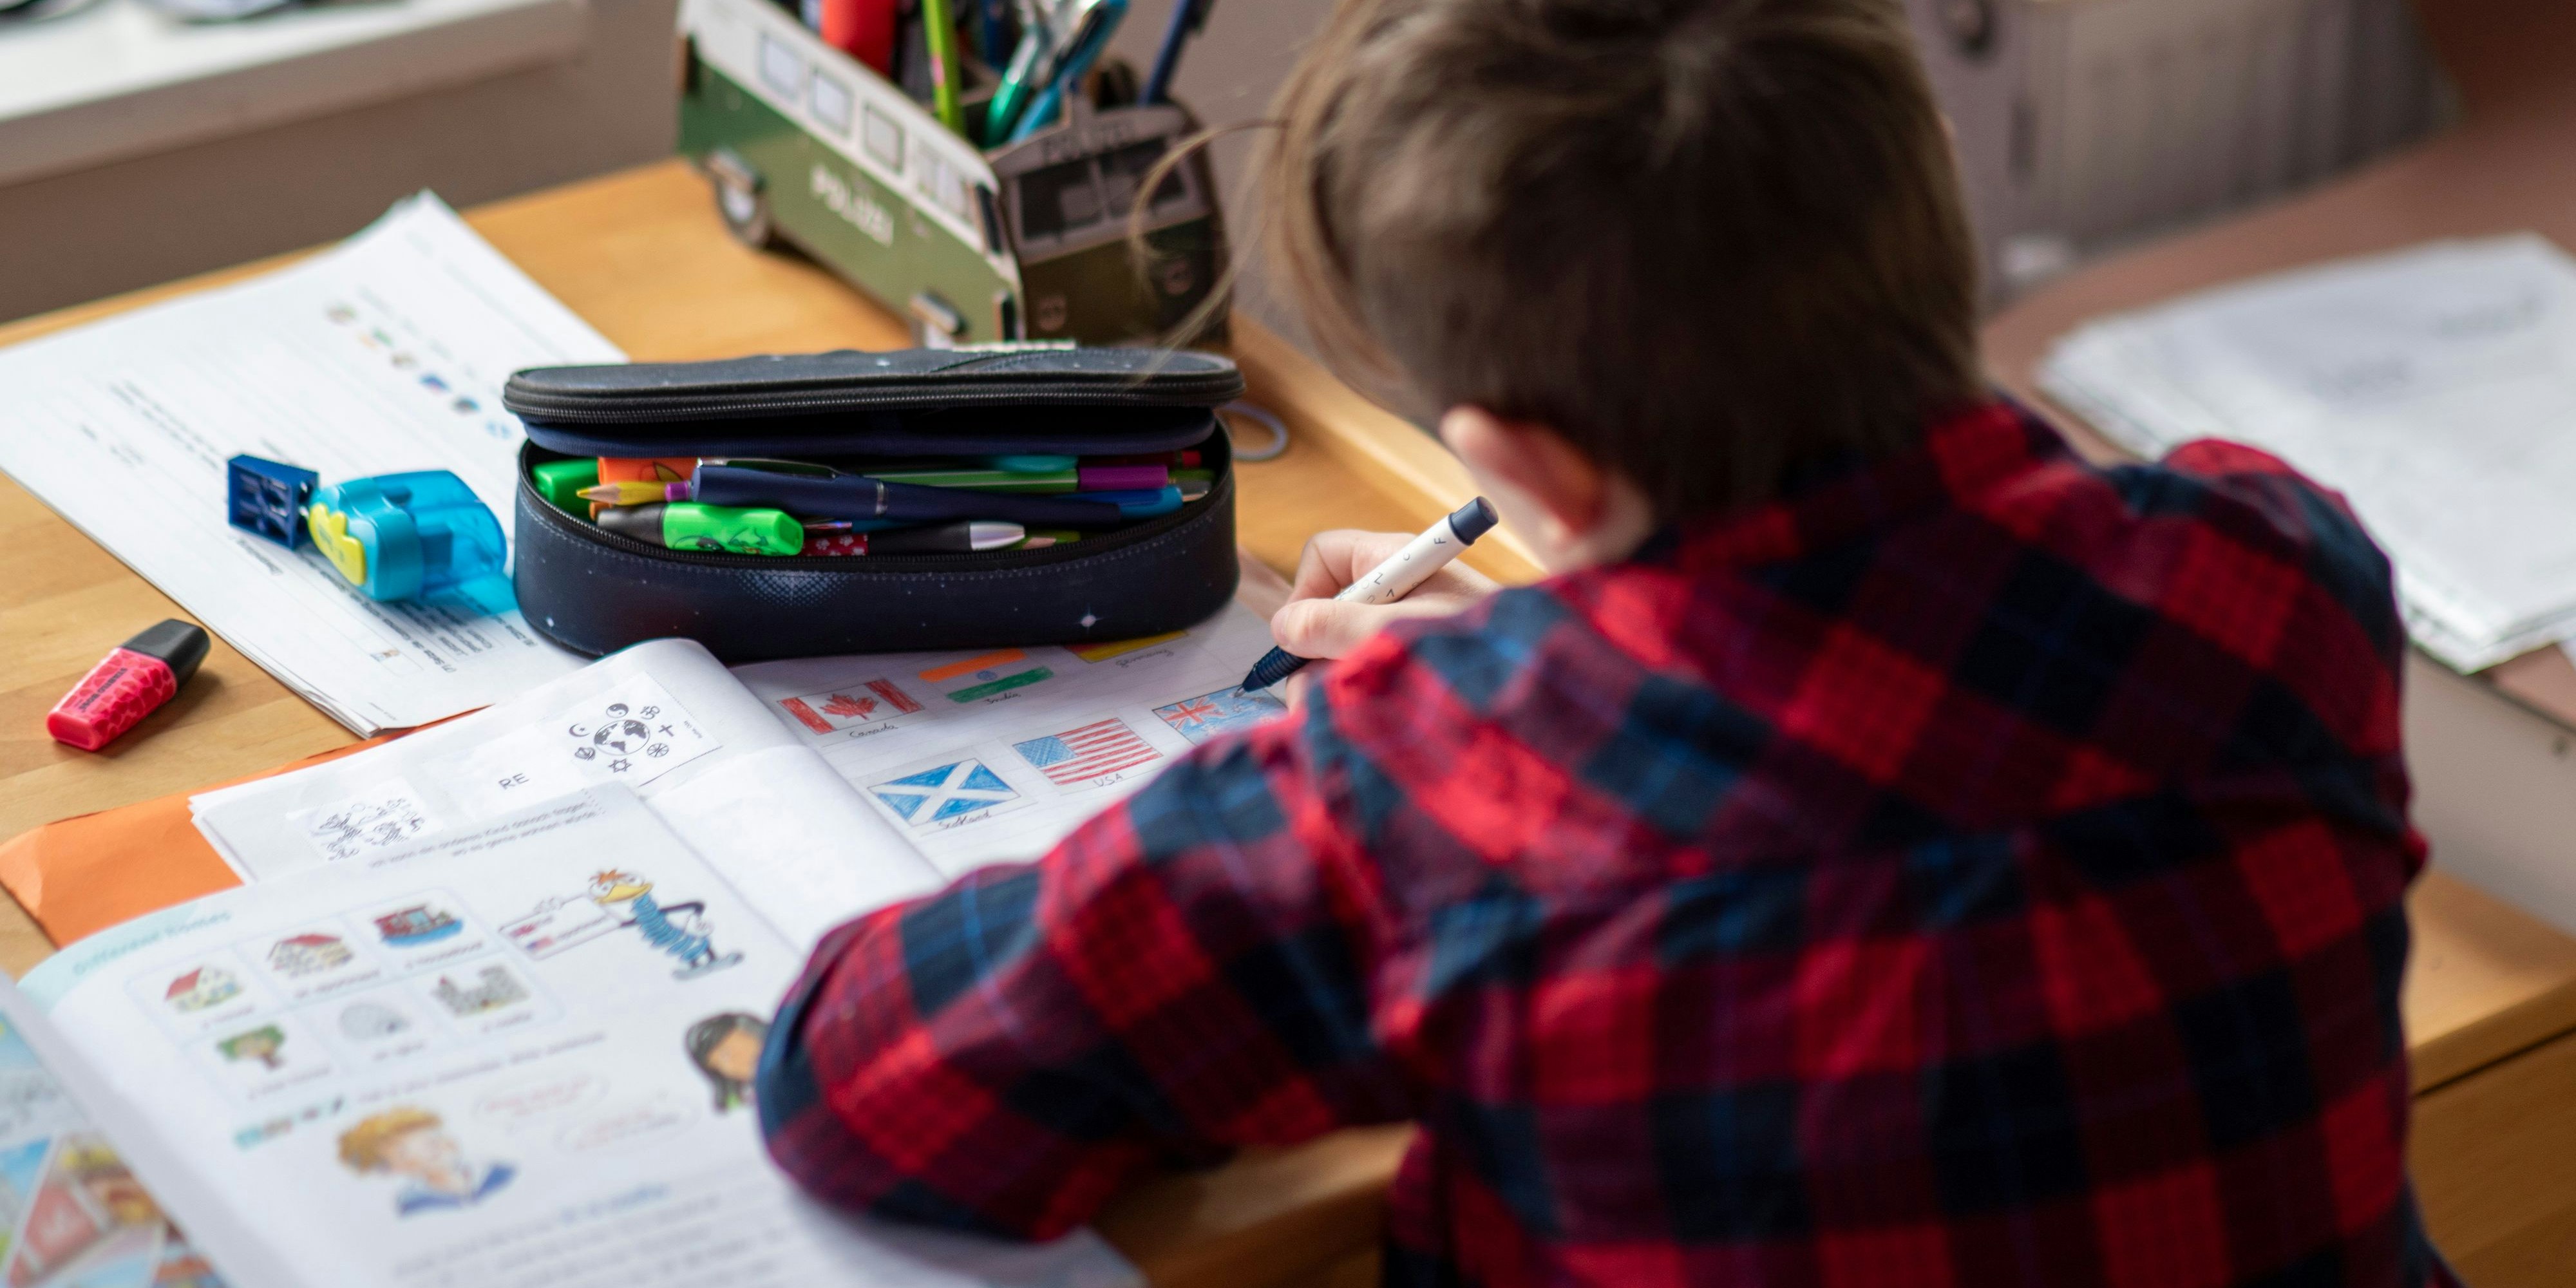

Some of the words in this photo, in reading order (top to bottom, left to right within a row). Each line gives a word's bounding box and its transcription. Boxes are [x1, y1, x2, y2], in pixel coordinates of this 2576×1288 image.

[849, 723, 899, 738] Canada
[498, 773, 530, 790] RE
[1093, 773, 1124, 786] USA
